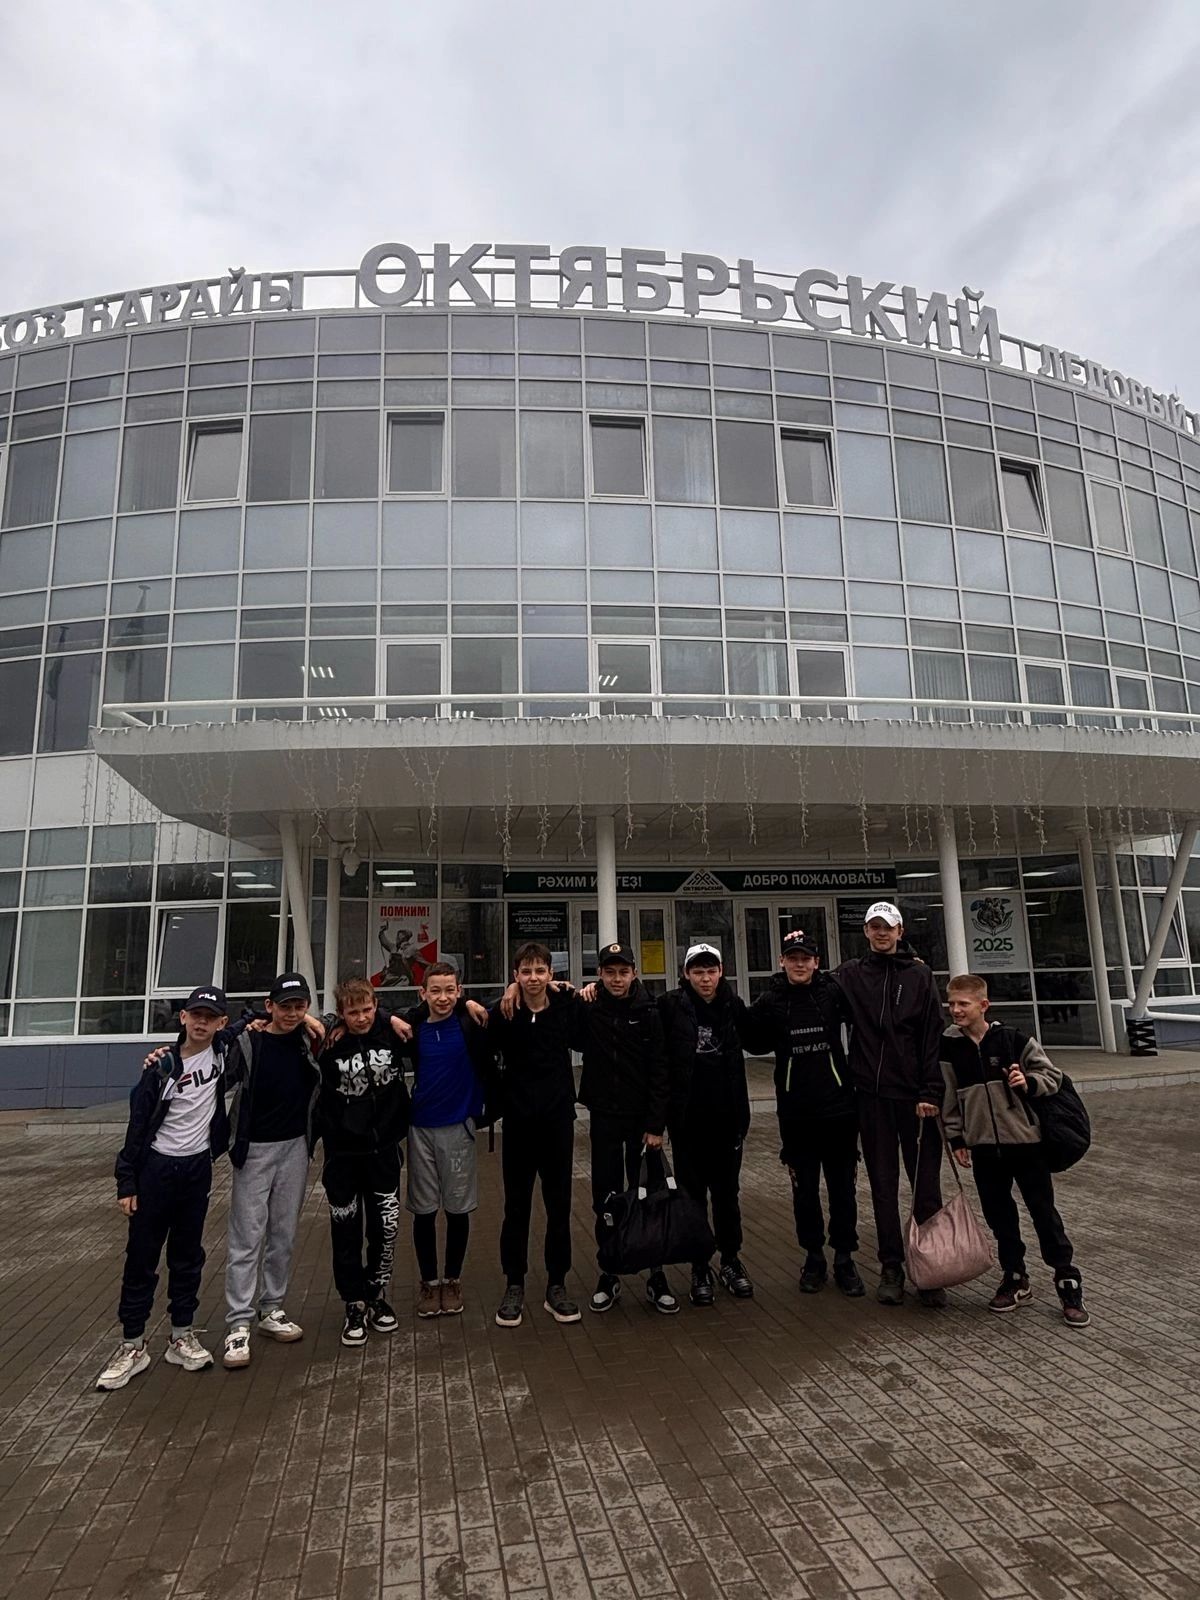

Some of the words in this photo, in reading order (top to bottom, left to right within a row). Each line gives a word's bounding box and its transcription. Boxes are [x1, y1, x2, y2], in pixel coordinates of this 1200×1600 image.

[359, 242, 1003, 364] ОКТЯБРЬСКИЙ
[1037, 343, 1188, 433] ЛЕДОВЫЙ
[743, 874, 788, 887] ДОБРО
[791, 872, 886, 886] ПОЖАЛОВАТЬ!
[380, 905, 430, 917] ПОМНИМ!
[973, 937, 1014, 952] 2025
[198, 993, 217, 1001] FILA
[177, 1063, 221, 1094] FILA
